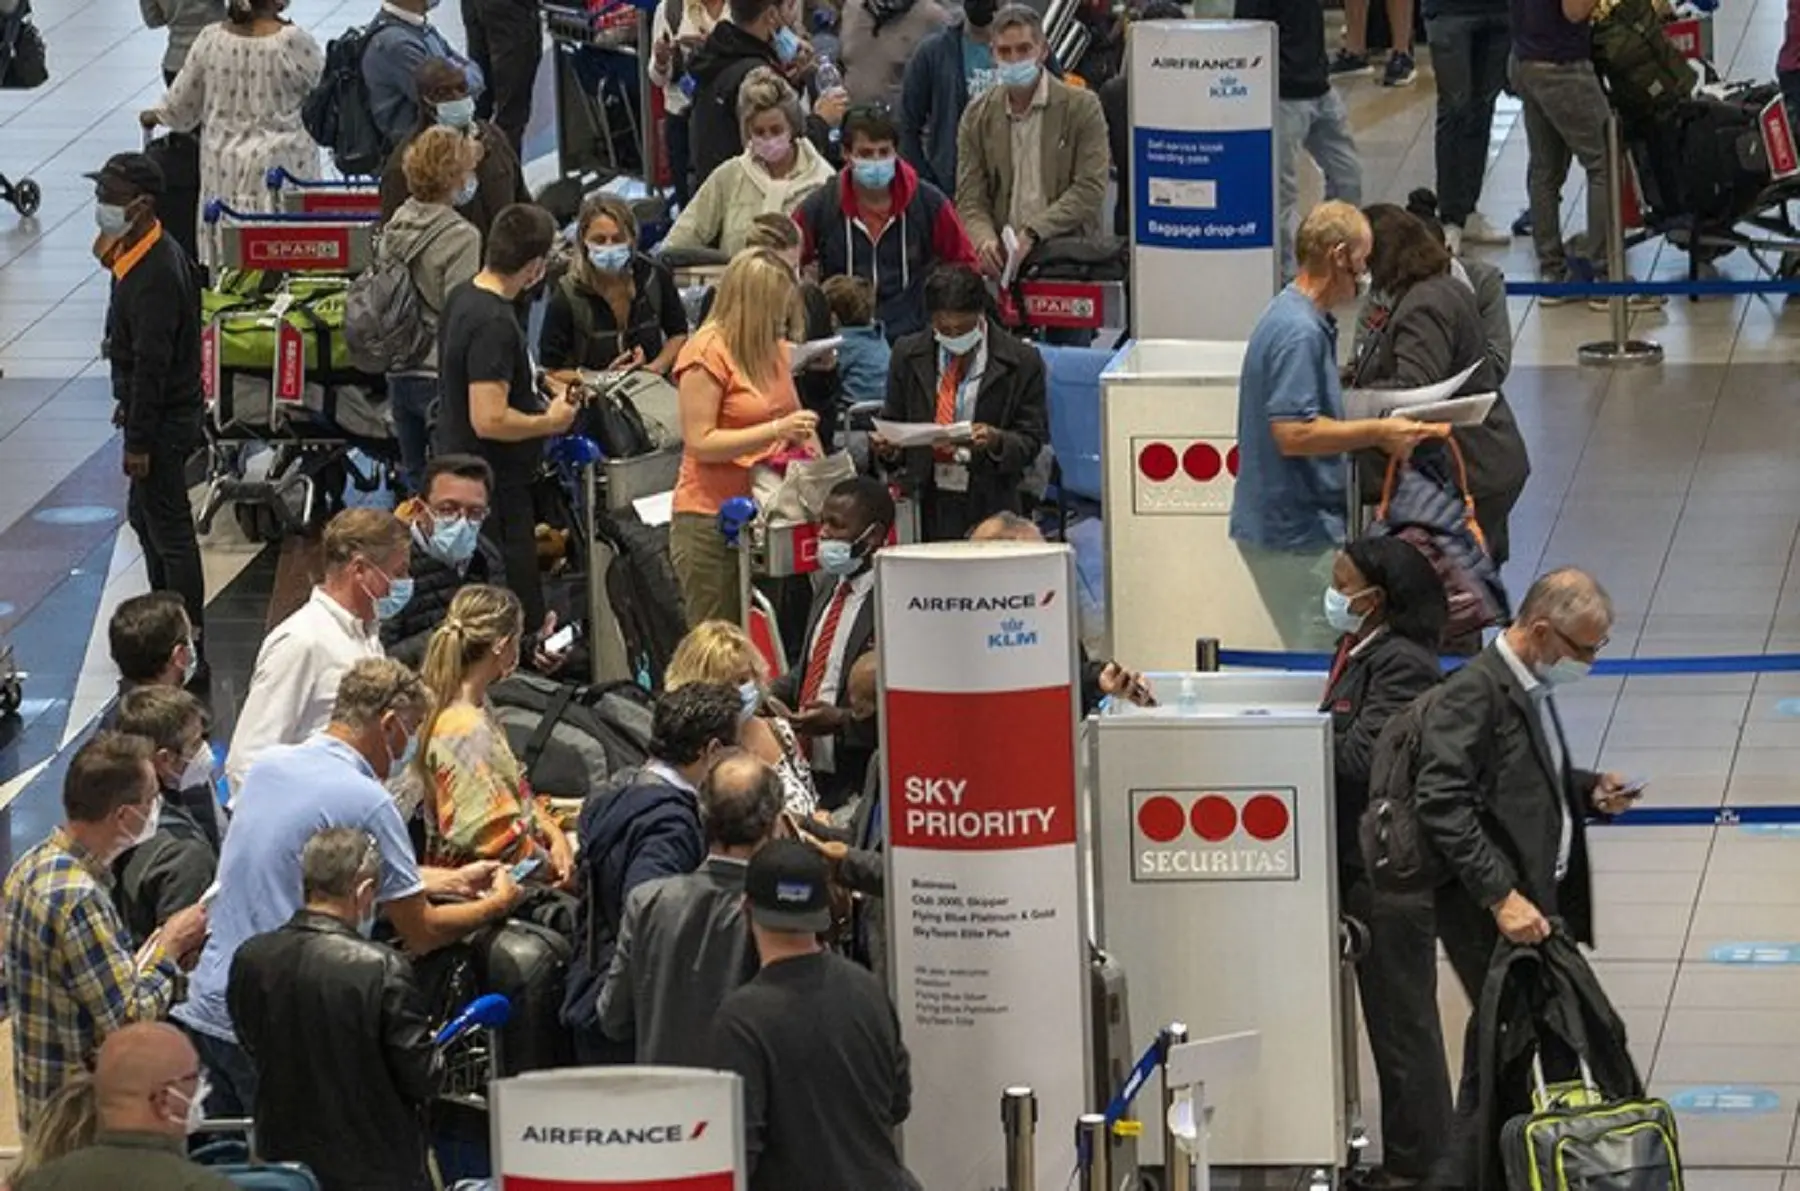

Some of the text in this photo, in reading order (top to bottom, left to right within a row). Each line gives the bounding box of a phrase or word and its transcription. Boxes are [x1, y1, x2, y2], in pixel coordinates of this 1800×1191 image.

[1210, 85, 1248, 97] KLM
[1148, 220, 1257, 238] Baggage drop-off
[908, 593, 1036, 611] AIRFRANCE
[988, 632, 1038, 648] KLM
[905, 774, 967, 805] SKY
[906, 806, 1056, 838] PRIORITY
[1141, 850, 1288, 873] SECURITAS
[912, 907, 1056, 924] Flying Blue Platinum & Gold
[522, 1125, 683, 1145] AIRFRANCE
